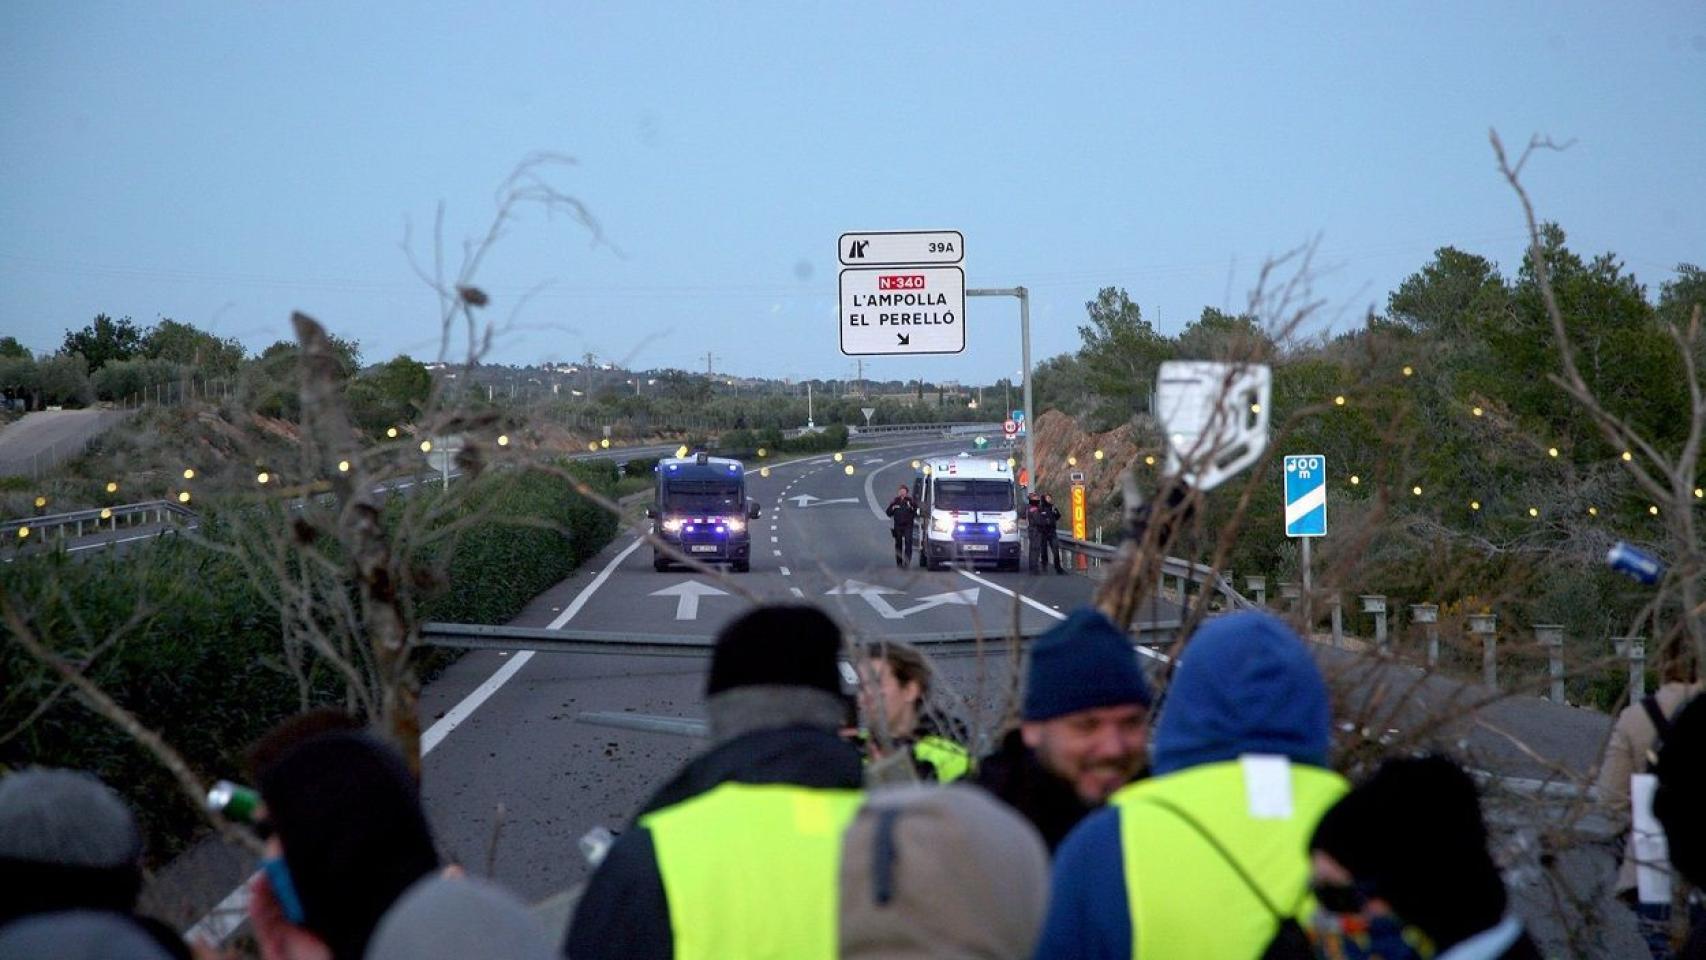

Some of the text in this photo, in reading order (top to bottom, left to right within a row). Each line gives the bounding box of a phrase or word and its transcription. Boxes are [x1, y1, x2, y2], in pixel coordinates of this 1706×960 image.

[928, 242, 955, 253] 39A
[881, 277, 924, 289] N-340
[853, 293, 947, 307] L'AMPOLLA
[849, 310, 955, 326] EL PERELLÓ
[1298, 470, 1311, 479] m
[1073, 487, 1084, 539] SOS
